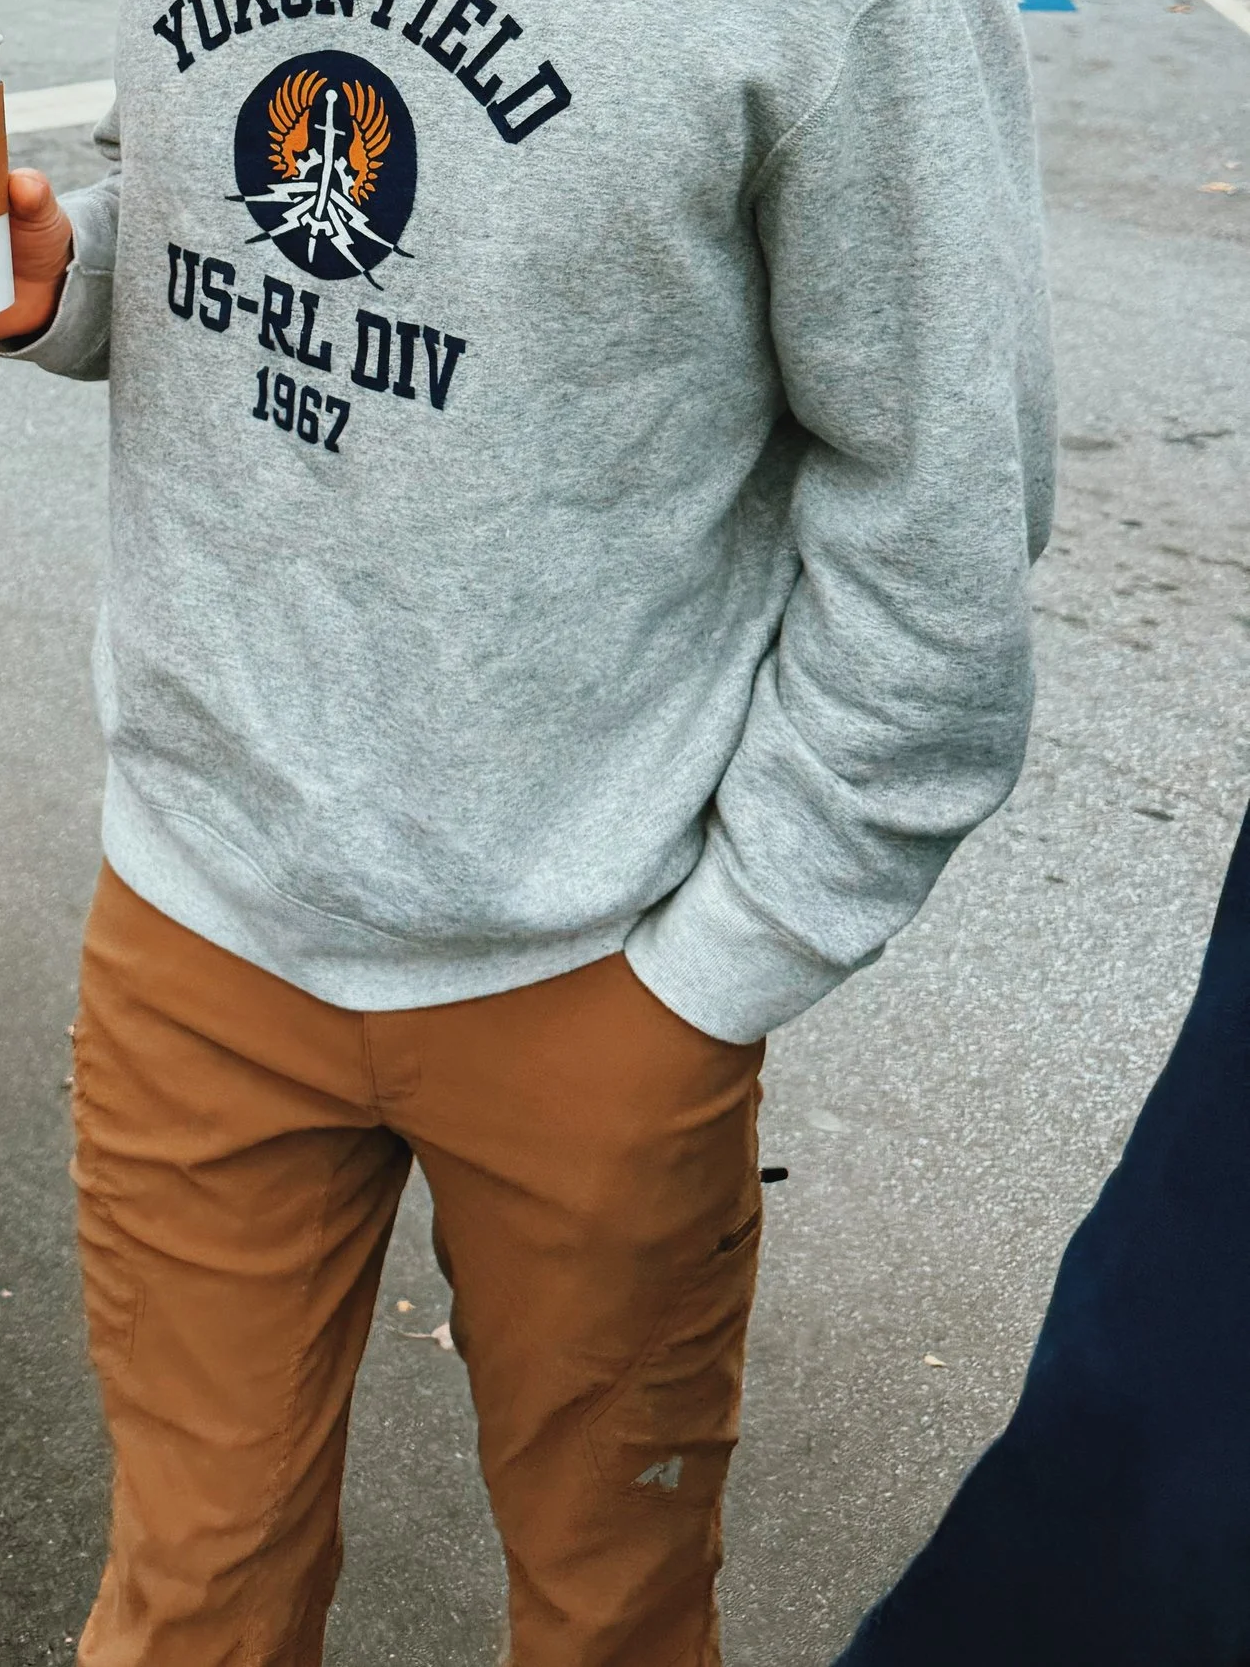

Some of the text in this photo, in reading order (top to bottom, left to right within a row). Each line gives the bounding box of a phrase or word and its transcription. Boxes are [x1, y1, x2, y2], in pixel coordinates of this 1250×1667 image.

[167, 243, 466, 411] US-RL DIV
[252, 366, 352, 454] 1967
